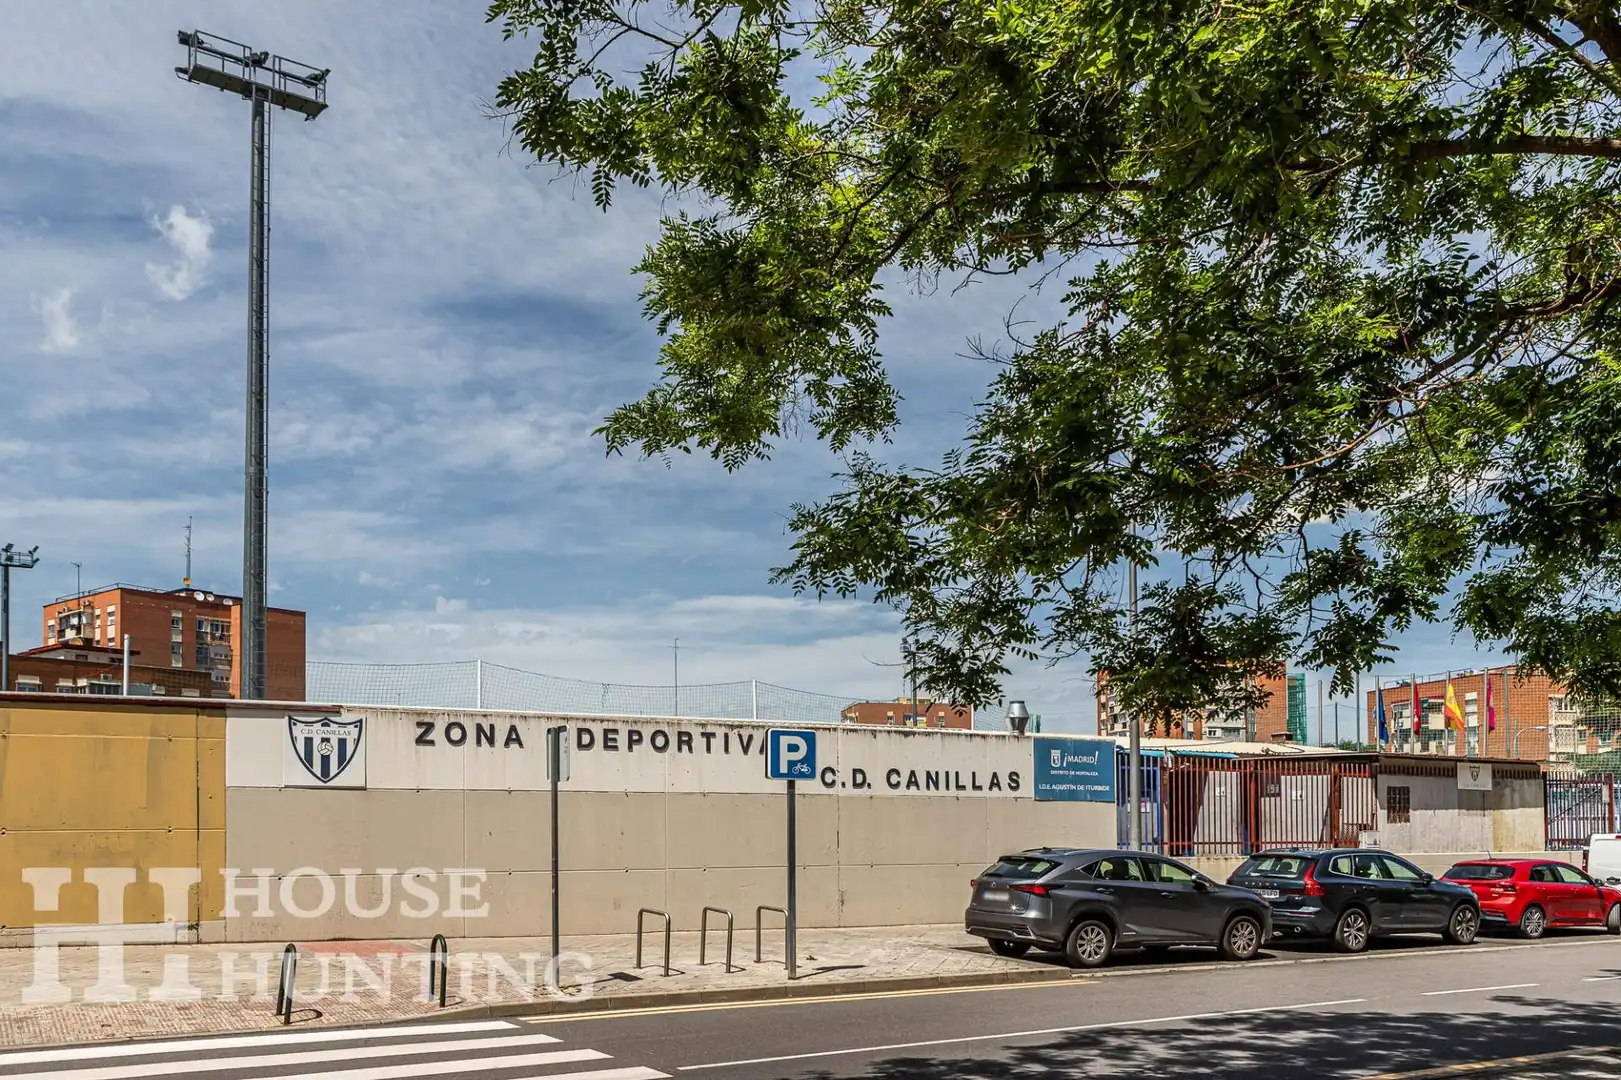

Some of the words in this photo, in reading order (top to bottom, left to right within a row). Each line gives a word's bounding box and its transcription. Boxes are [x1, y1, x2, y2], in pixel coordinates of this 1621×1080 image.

[415, 721, 524, 749] ZONA
[779, 735, 808, 774] P
[820, 766, 872, 790] C.D.
[886, 767, 1021, 792] CANILLAS
